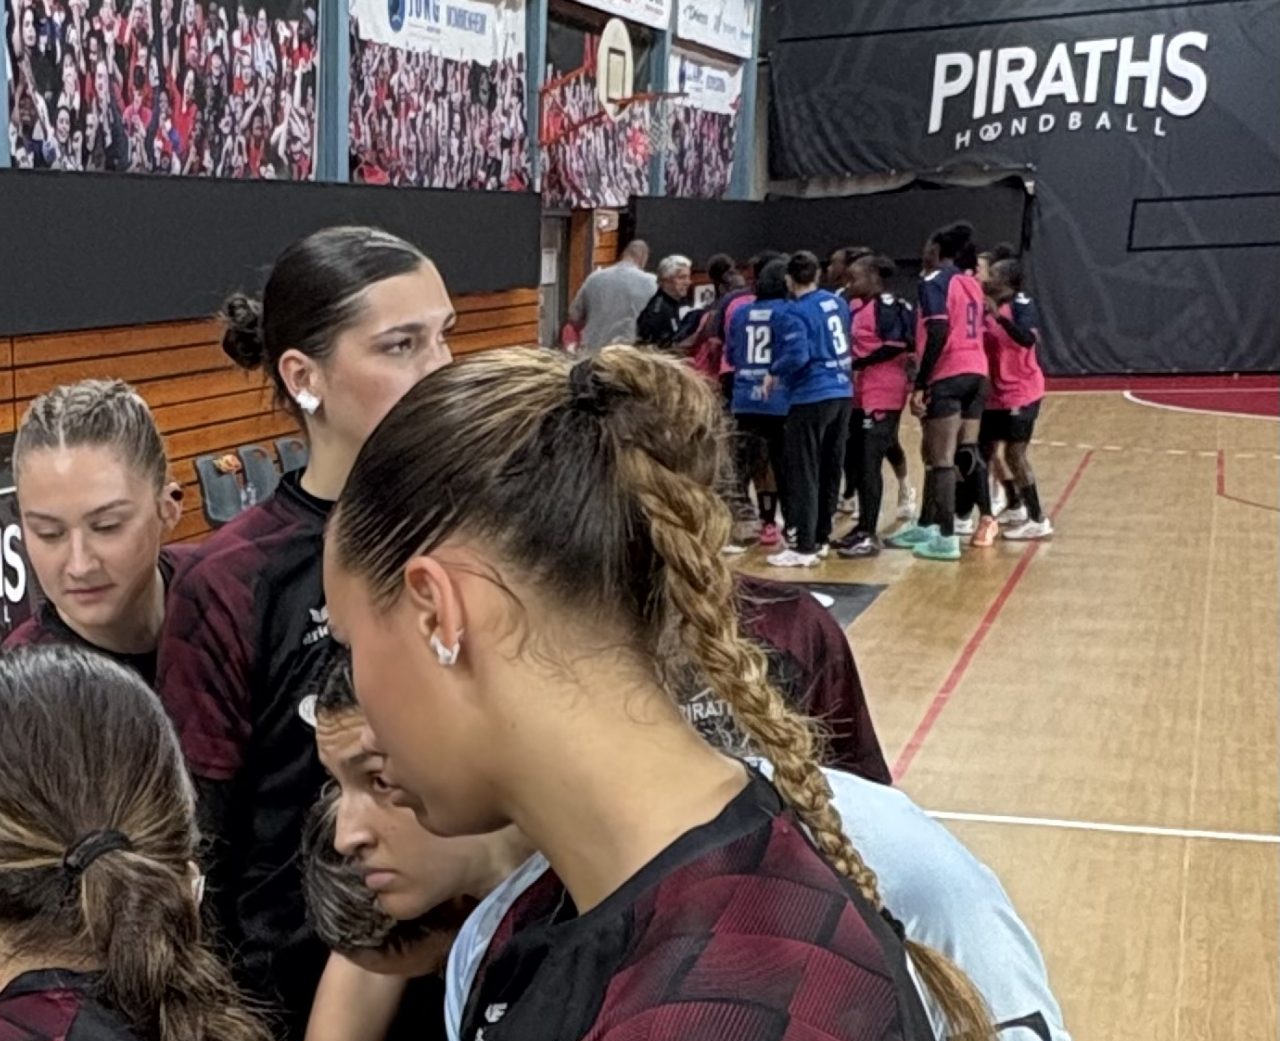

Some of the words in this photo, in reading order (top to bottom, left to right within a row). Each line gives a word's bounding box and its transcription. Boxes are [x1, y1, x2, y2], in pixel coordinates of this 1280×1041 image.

[928, 31, 1209, 134] PIRATHS
[745, 325, 772, 365] 12
[827, 314, 848, 356] 3
